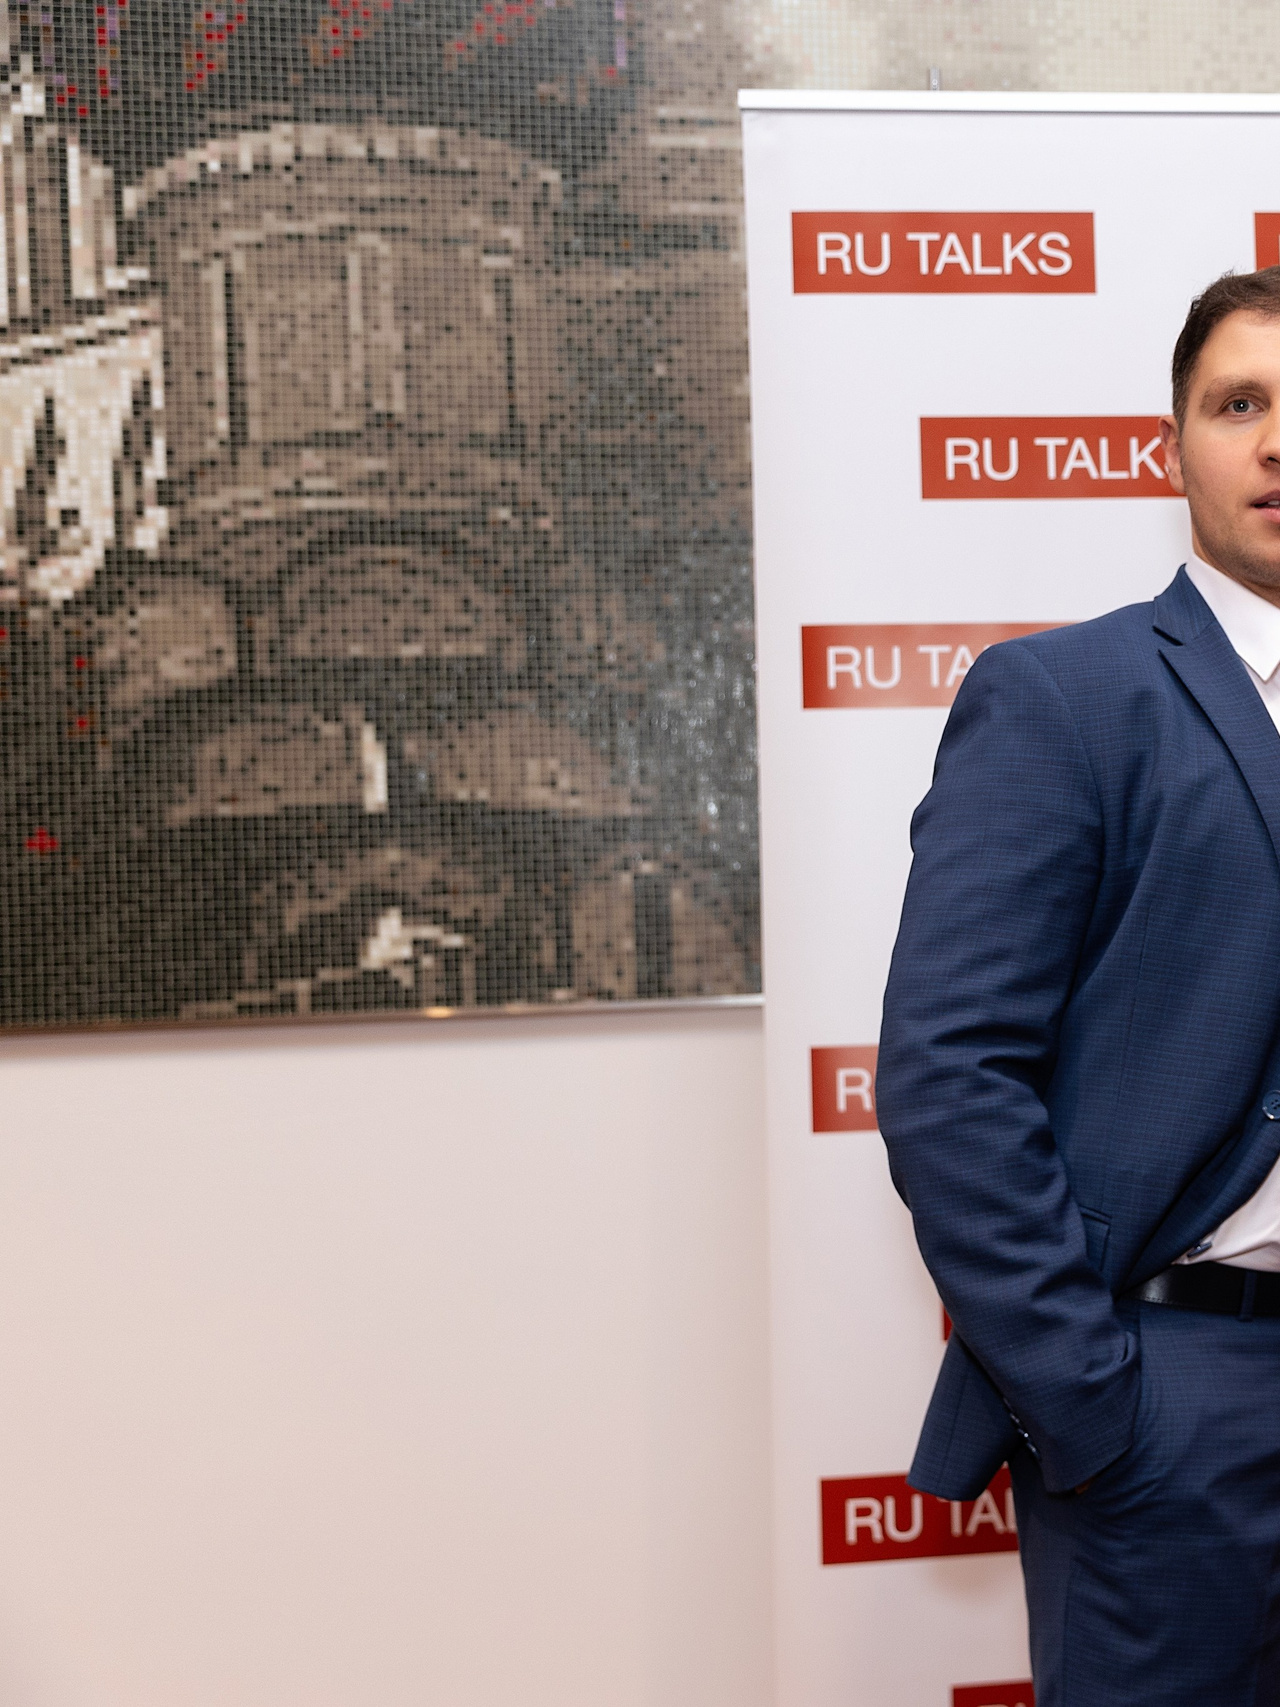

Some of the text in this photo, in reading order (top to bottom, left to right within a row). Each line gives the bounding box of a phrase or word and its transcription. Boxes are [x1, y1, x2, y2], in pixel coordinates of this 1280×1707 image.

[816, 230, 1073, 277] RU TALKS
[944, 436, 1171, 483] RU TALK
[826, 644, 902, 691] RU
[835, 1067, 874, 1114] R
[845, 1494, 923, 1545] RU
